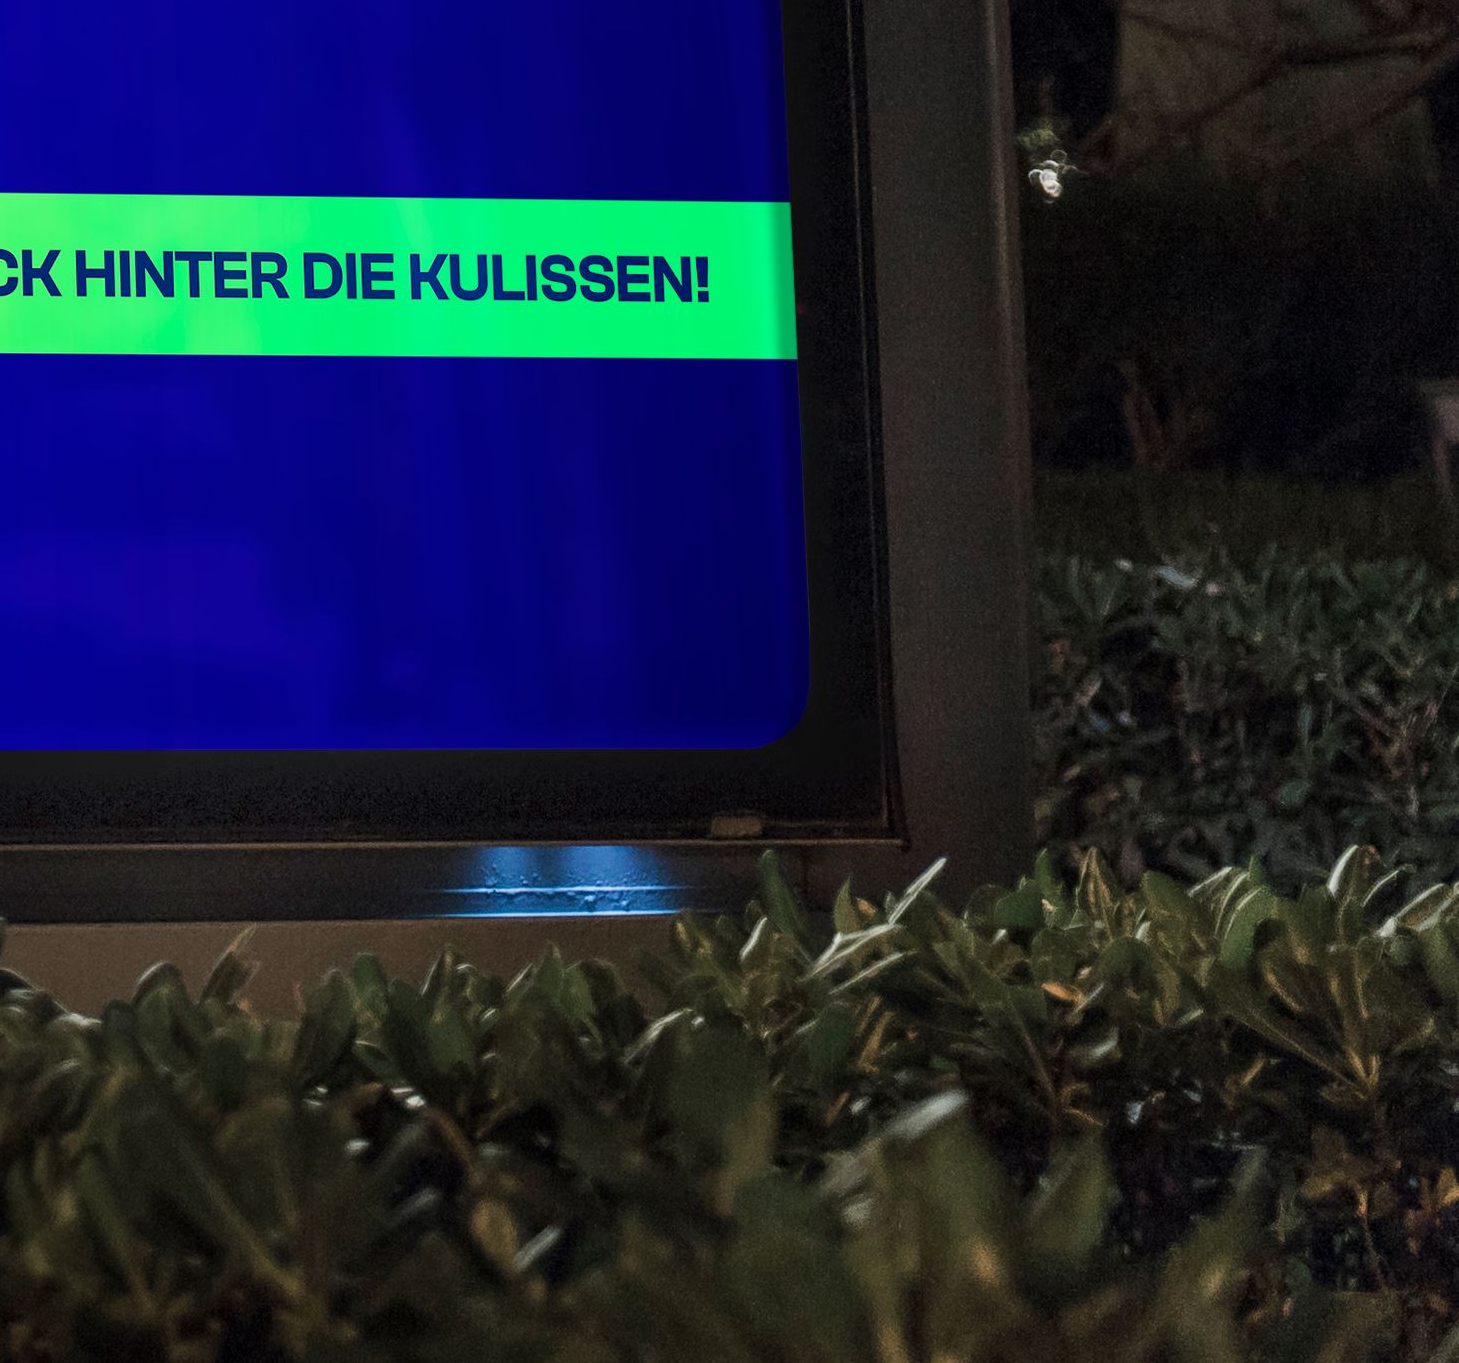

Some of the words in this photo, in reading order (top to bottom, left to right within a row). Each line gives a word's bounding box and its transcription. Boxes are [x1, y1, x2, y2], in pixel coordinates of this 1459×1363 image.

[75, 249, 290, 299] HINTER
[303, 252, 396, 300] DIE
[409, 253, 710, 303] KULISSEN!
